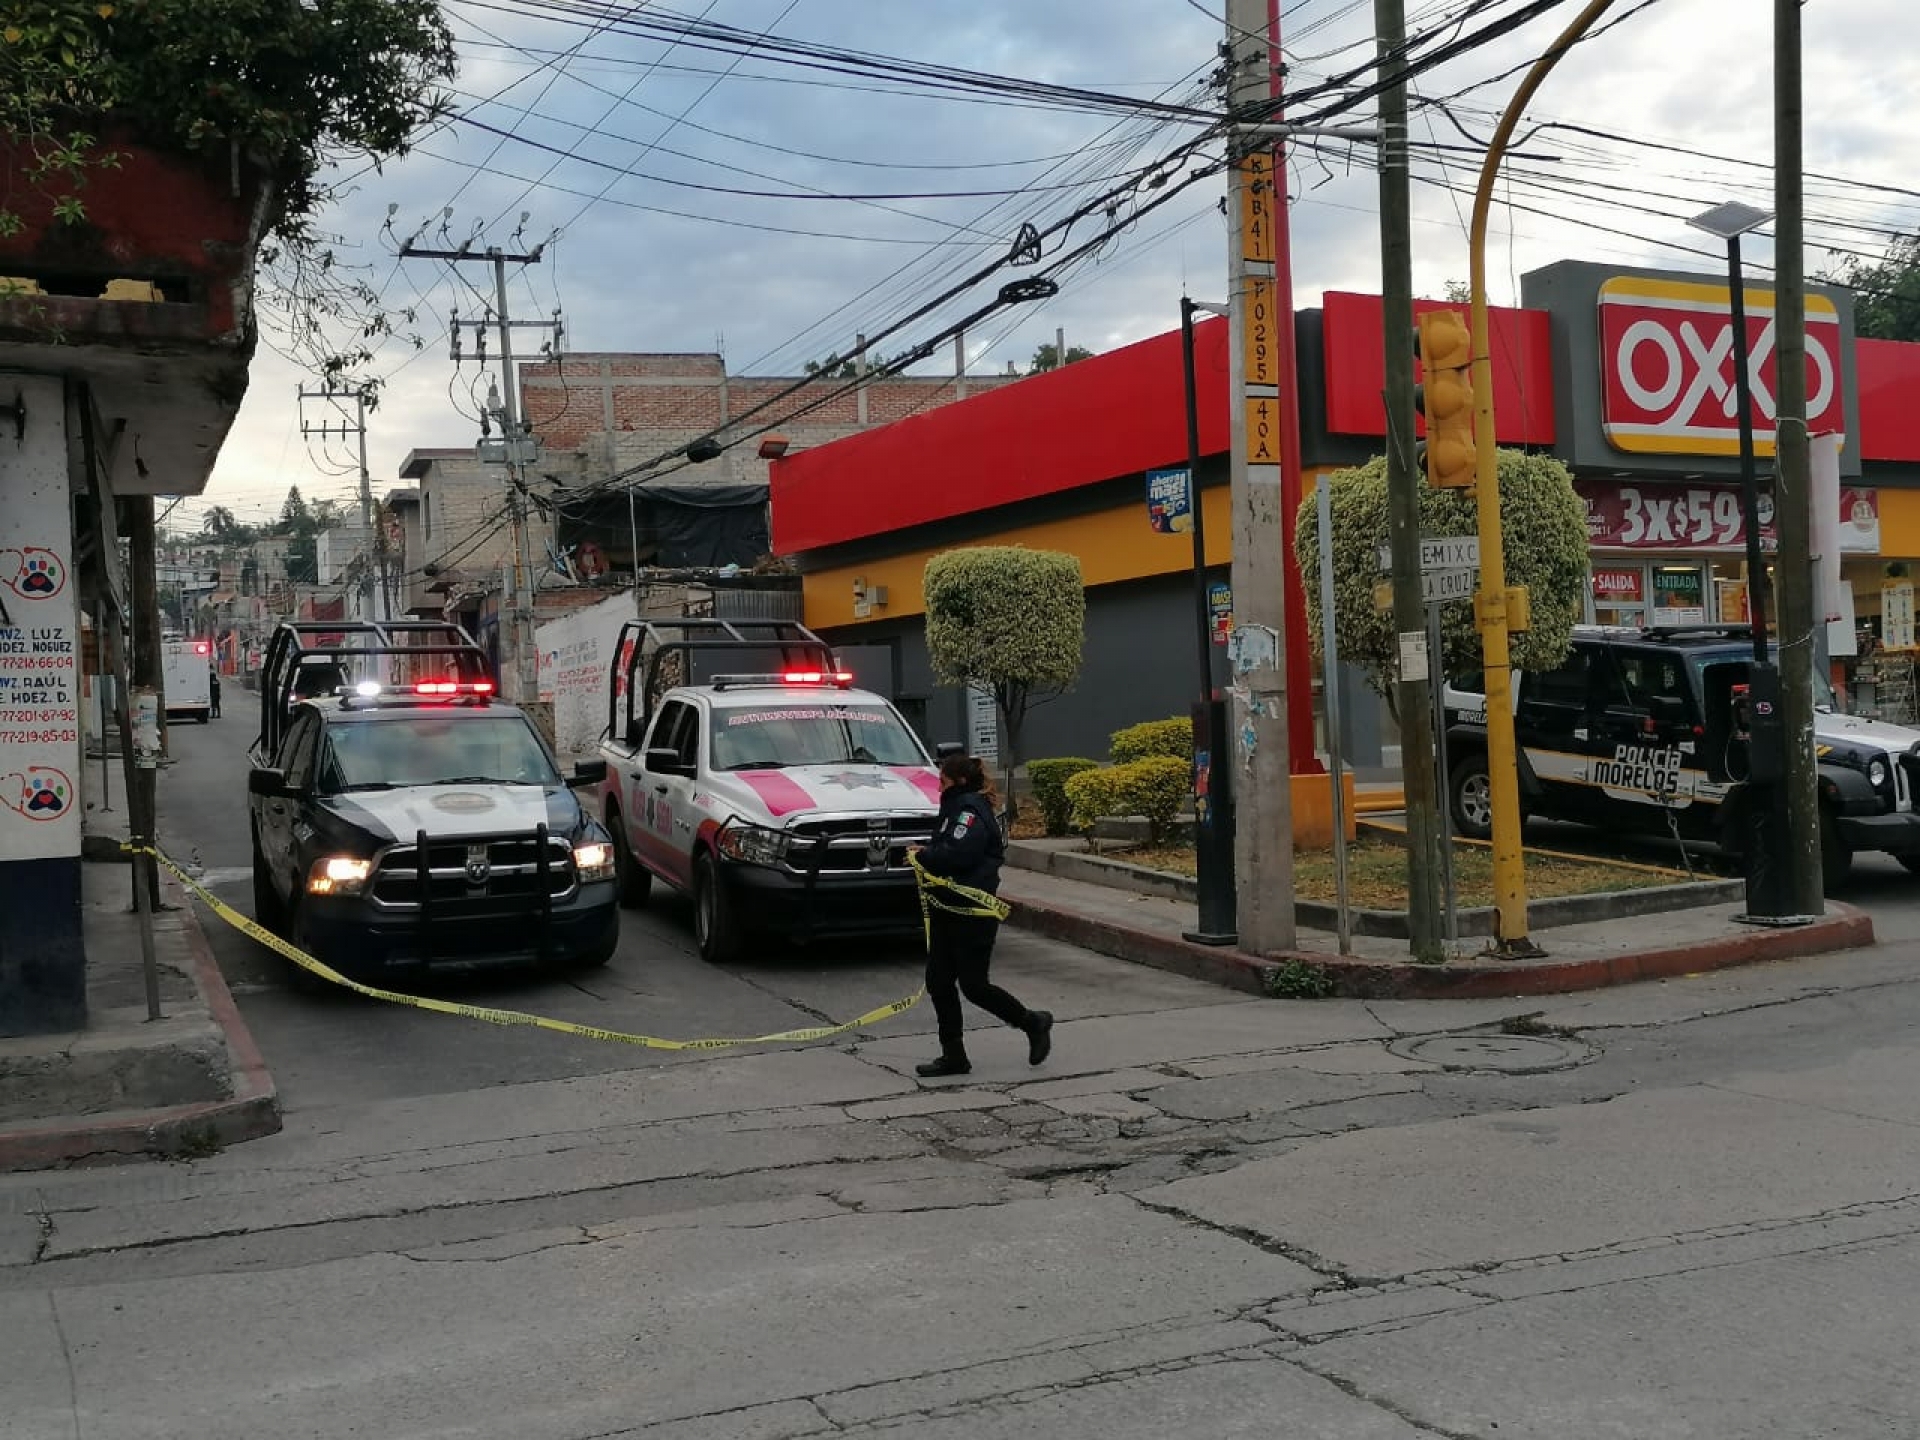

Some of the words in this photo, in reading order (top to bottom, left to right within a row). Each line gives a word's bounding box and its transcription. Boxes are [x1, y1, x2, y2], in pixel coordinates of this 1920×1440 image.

[1617, 319, 1834, 427] OXXO
[1254, 400, 1272, 459] 40A
[1598, 574, 1636, 590] SALIDA
[1656, 574, 1699, 591] ENTRADA
[31, 628, 62, 640] LUZ
[0, 641, 29, 653] DEZ.
[32, 641, 72, 653] NOGUEZ
[11, 691, 52, 704] HDEZ.
